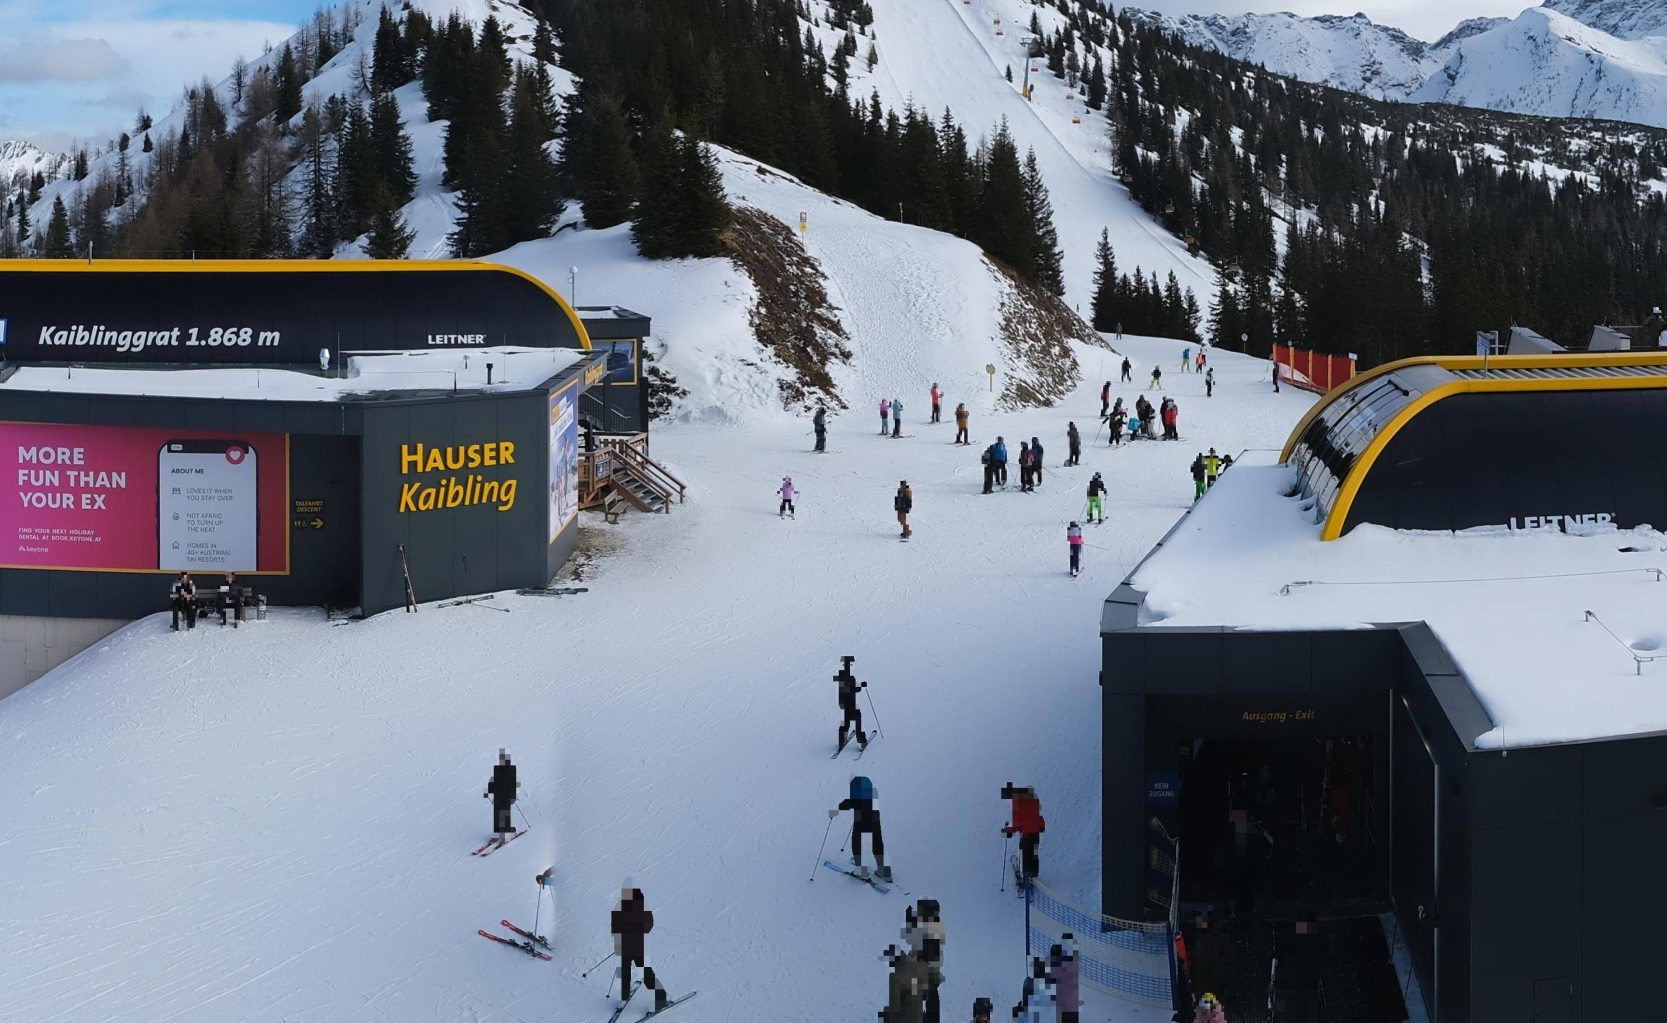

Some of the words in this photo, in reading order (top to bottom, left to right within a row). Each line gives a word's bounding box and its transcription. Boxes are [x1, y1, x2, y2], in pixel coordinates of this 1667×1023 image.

[38, 325, 181, 352] Kaiblinggrat
[185, 327, 253, 346] 1.868
[257, 330, 280, 346] m
[18, 446, 85, 465] MORE
[18, 469, 60, 487] FUN
[66, 470, 126, 488] THAN
[19, 492, 75, 509] YOUR
[81, 493, 107, 510] EX
[399, 474, 518, 513] Kaibling
[1241, 711, 1287, 723] Ausgang
[1295, 709, 1316, 720] Exit
[1149, 790, 1175, 798] ZUGANG
